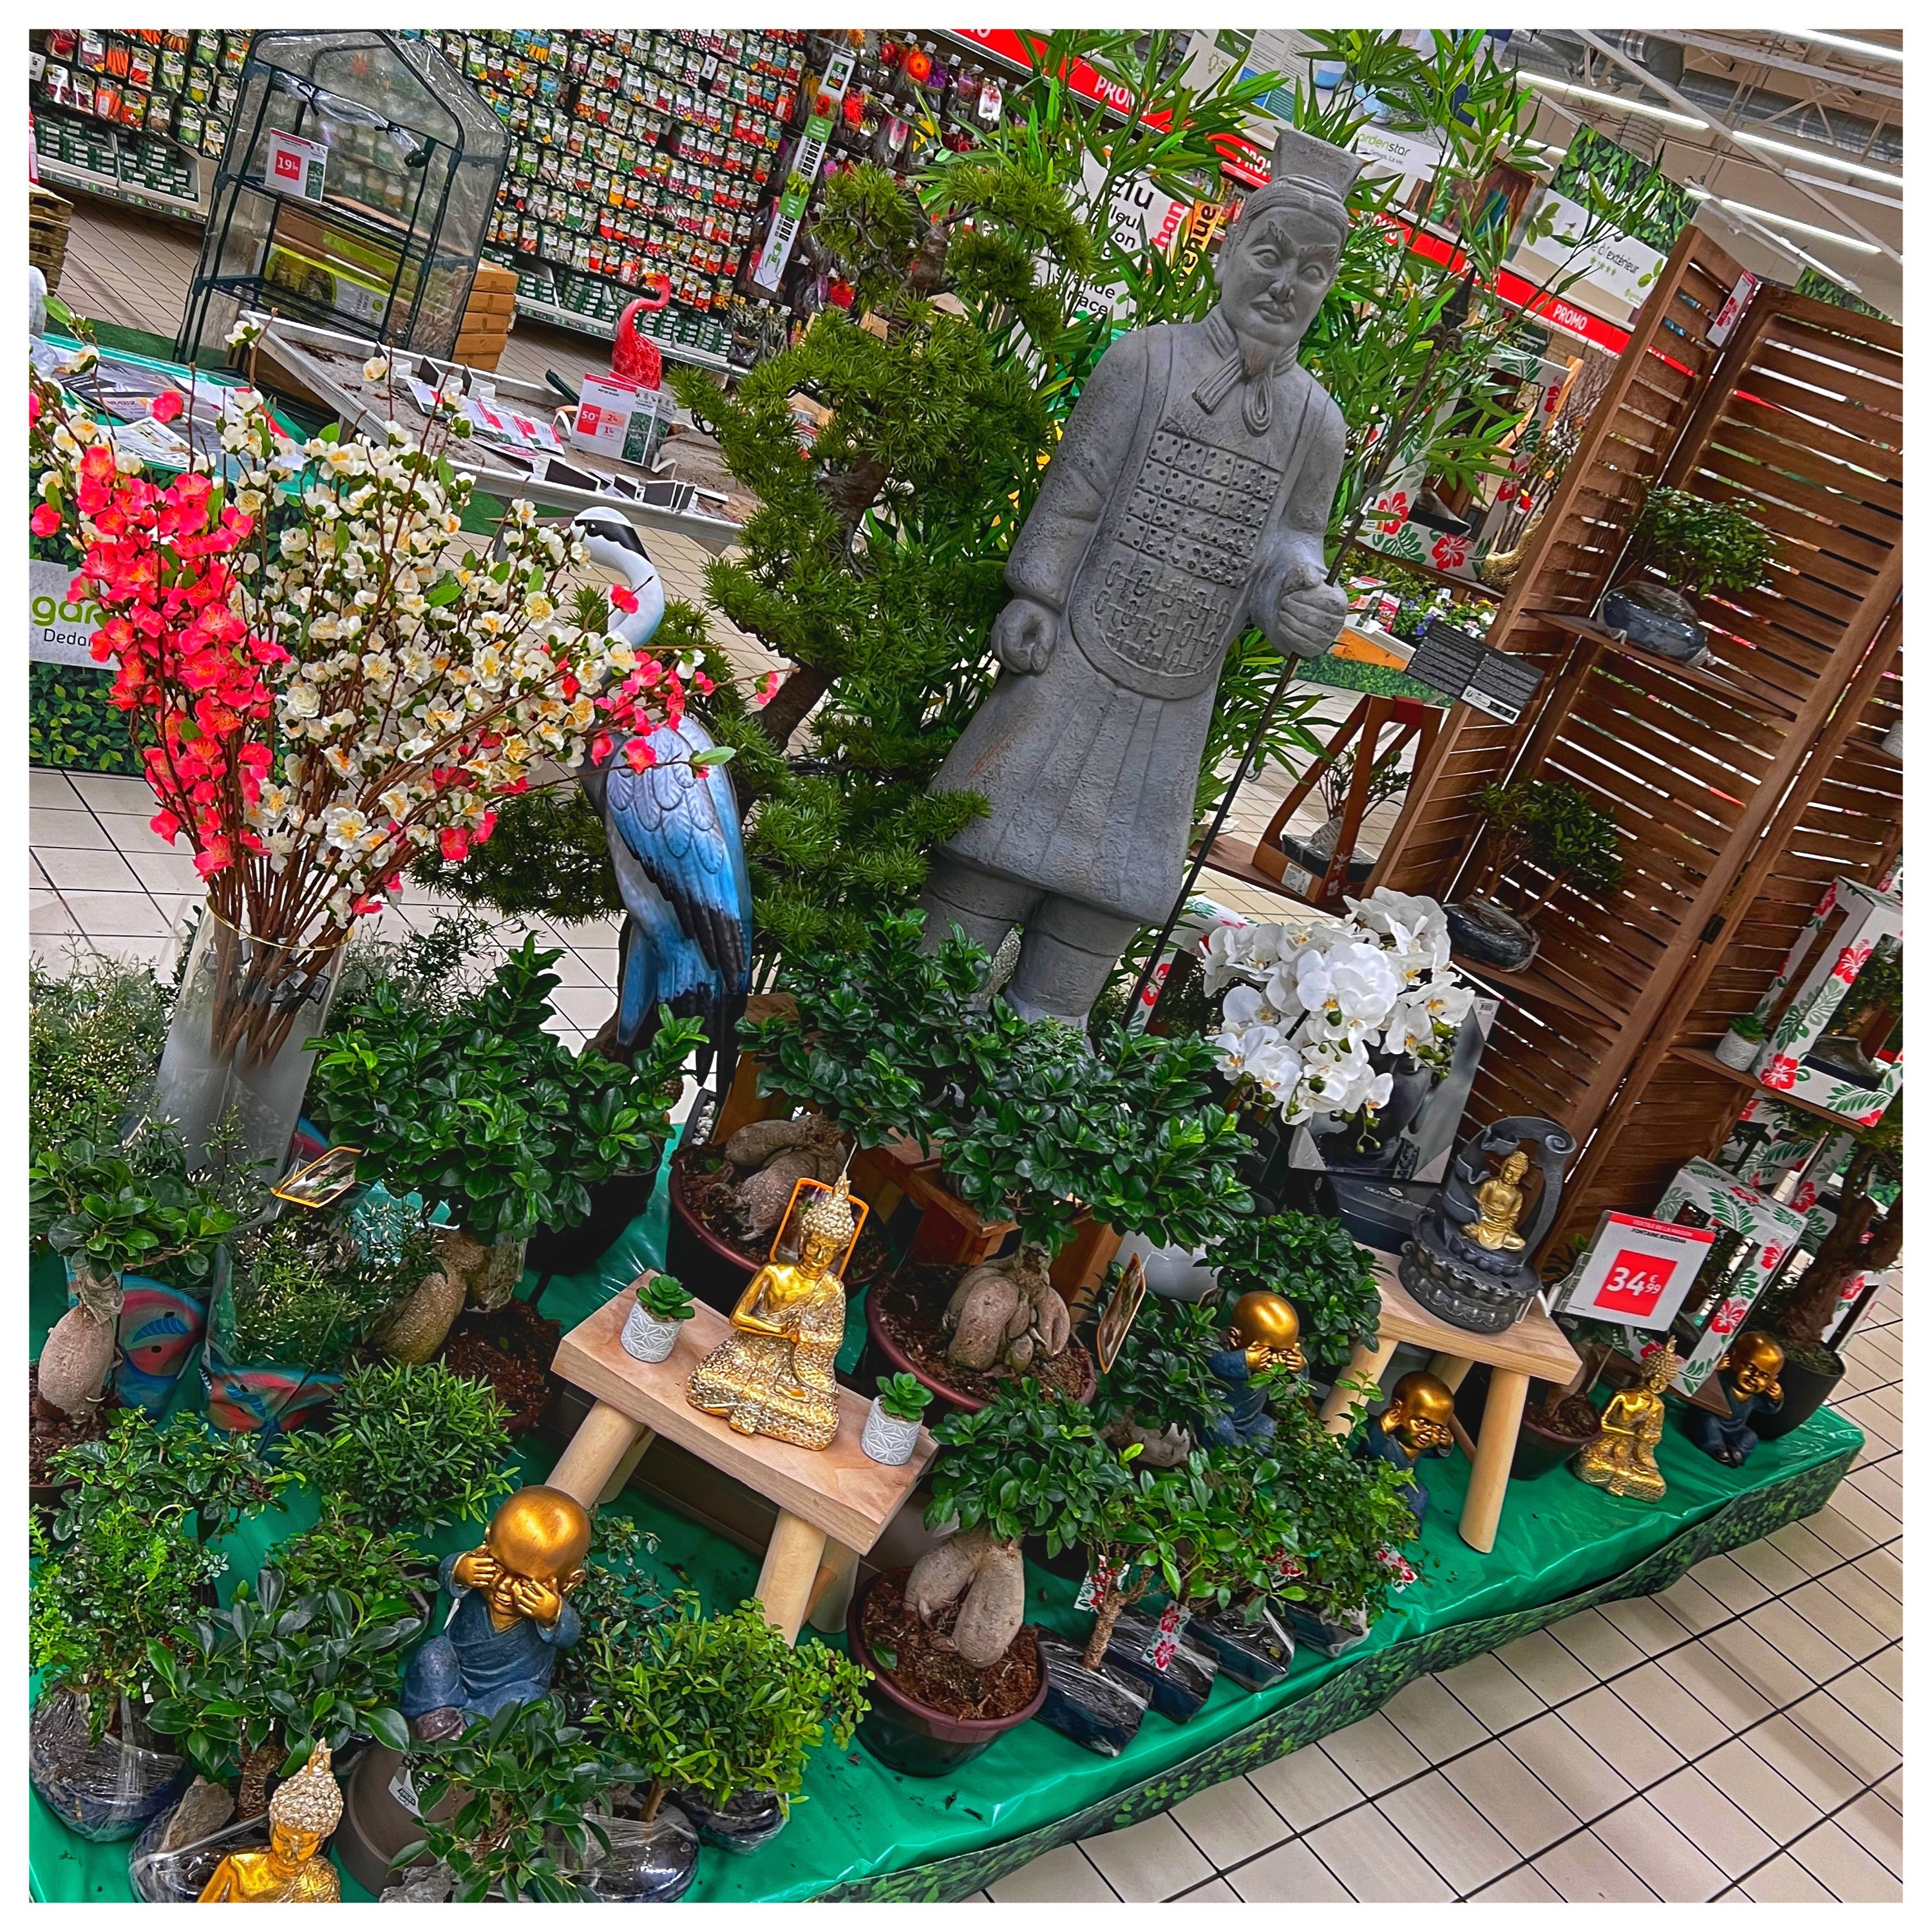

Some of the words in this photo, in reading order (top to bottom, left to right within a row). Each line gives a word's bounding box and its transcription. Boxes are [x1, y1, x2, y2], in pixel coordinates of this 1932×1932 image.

[1552, 303, 1588, 331] PROMO
[1606, 1266, 1647, 1297] 34
[1645, 1282, 1662, 1294] 99
